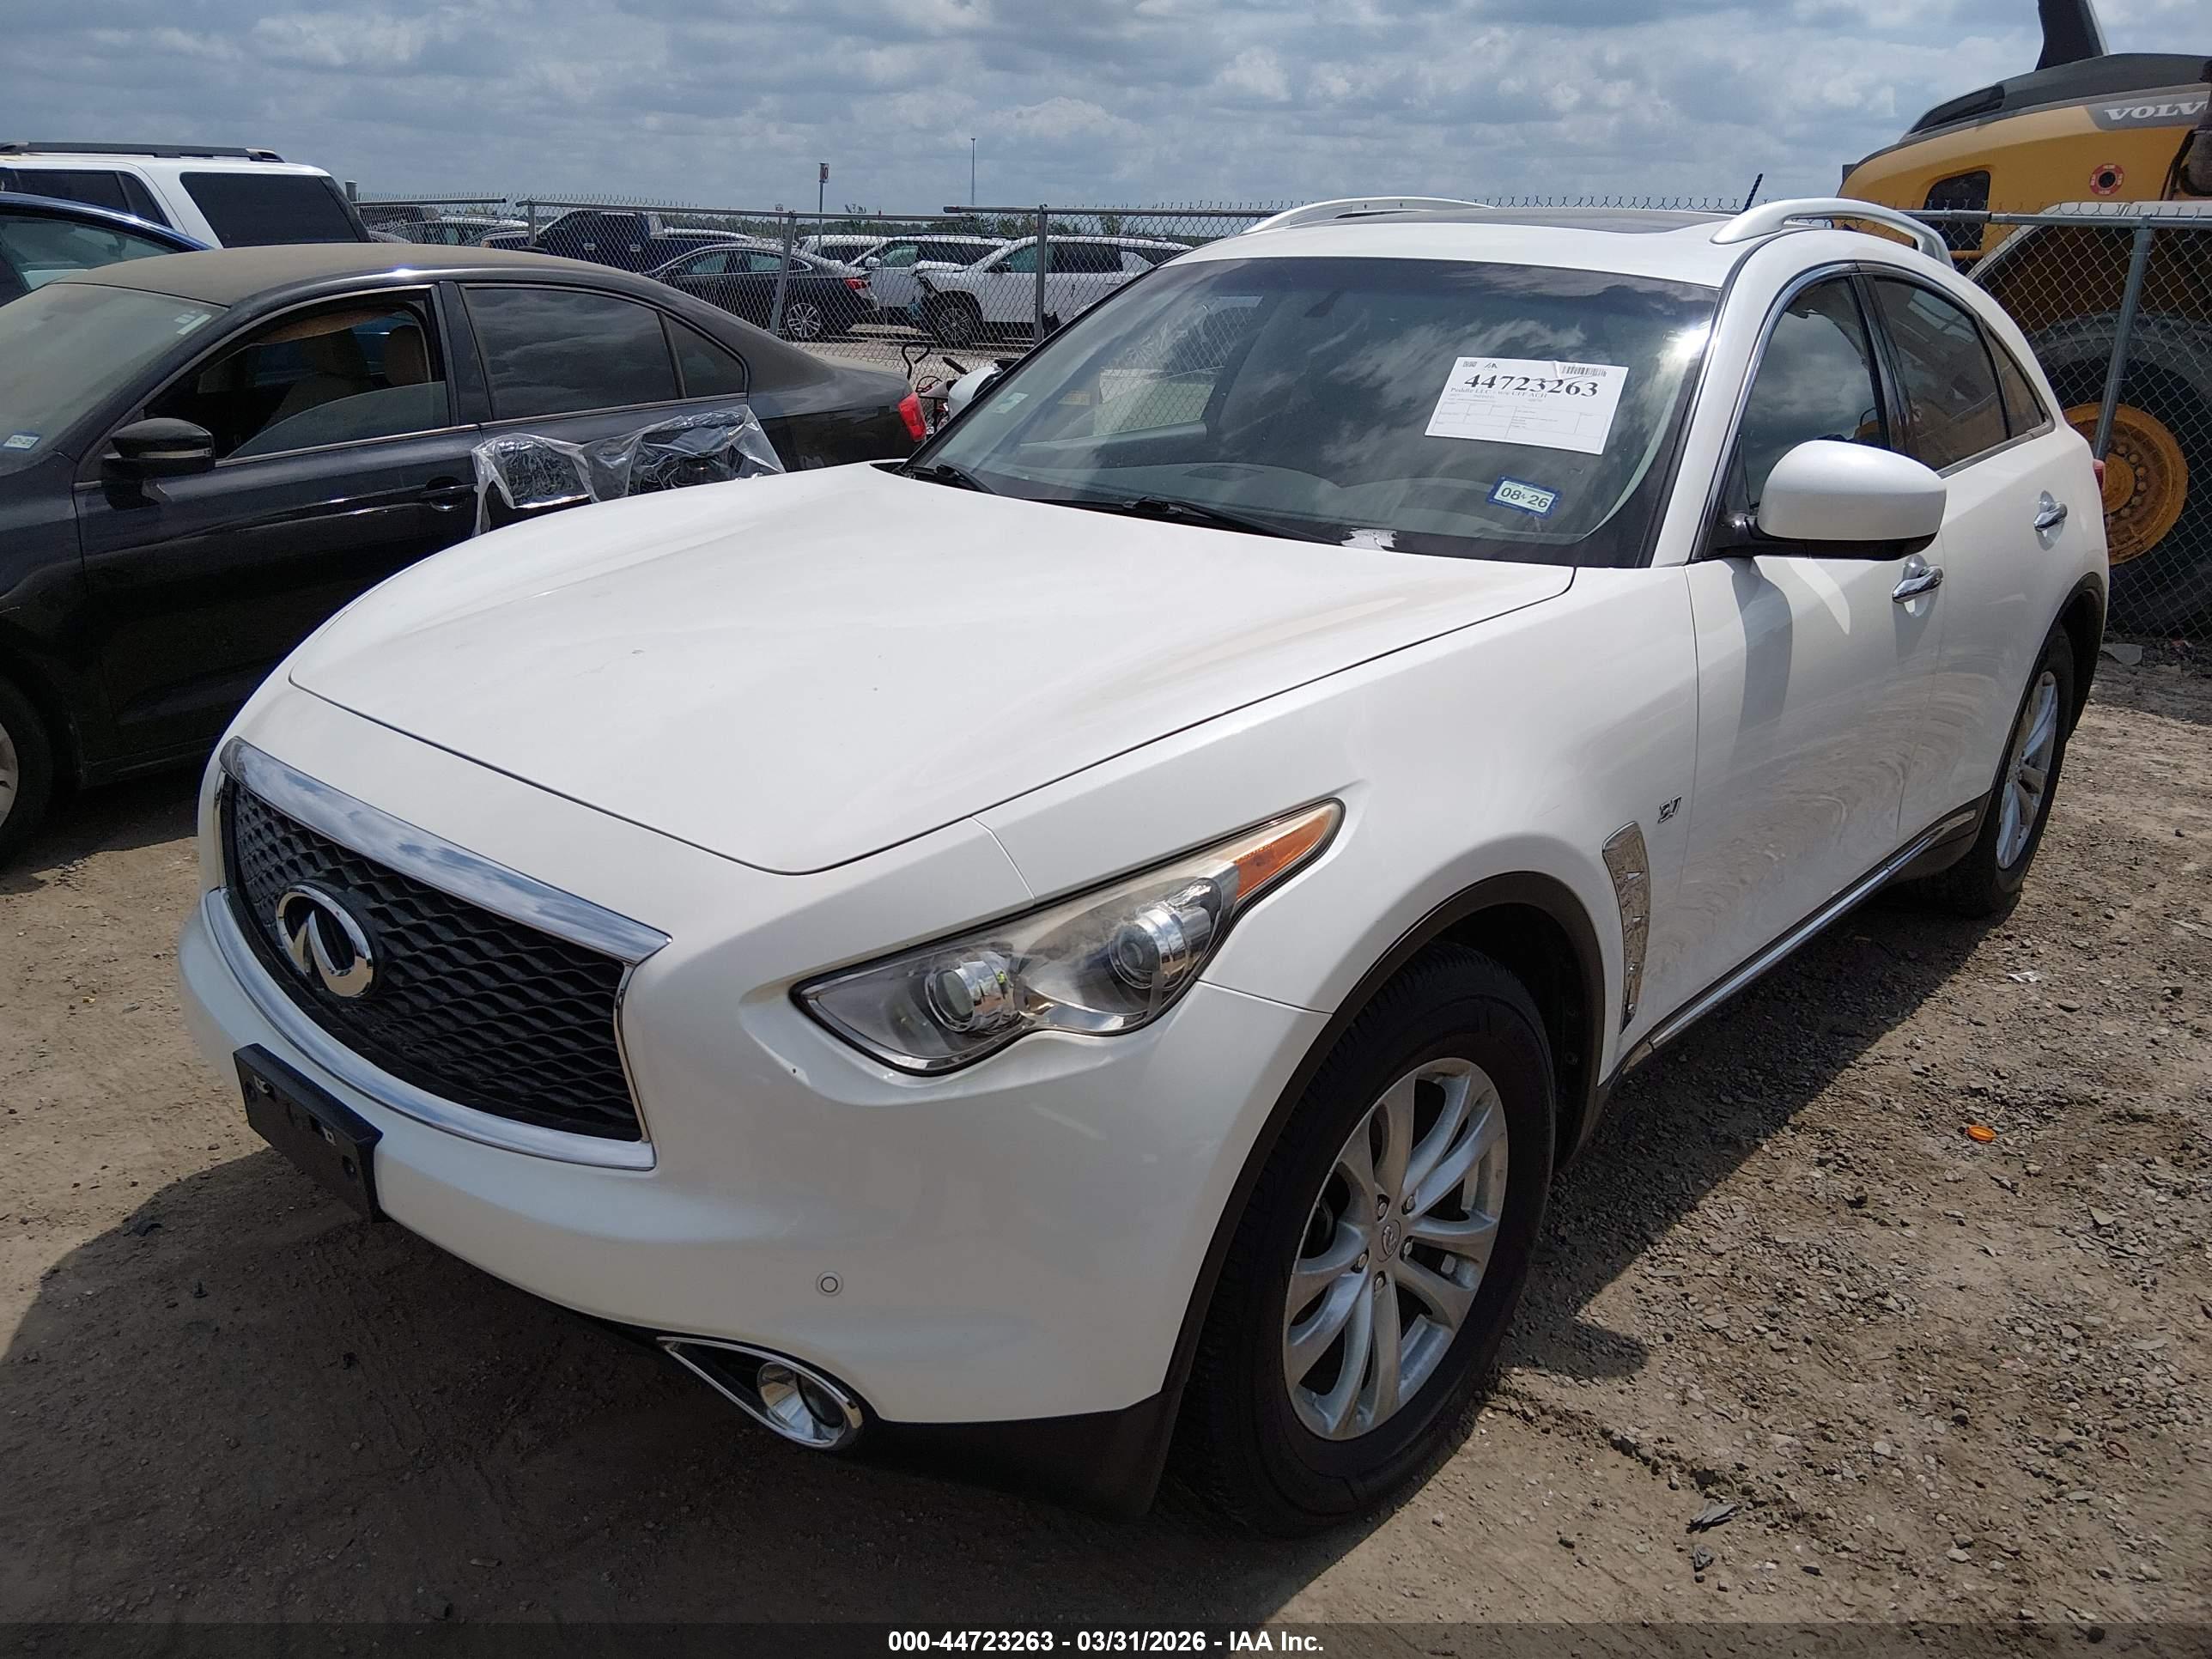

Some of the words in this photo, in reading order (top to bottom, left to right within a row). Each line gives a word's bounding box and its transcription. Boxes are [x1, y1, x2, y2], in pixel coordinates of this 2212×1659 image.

[2104, 100, 2209, 120] VOLV
[1464, 374, 1598, 397] 44723263
[1500, 487, 1522, 501] 08
[1527, 495, 1549, 508] 26
